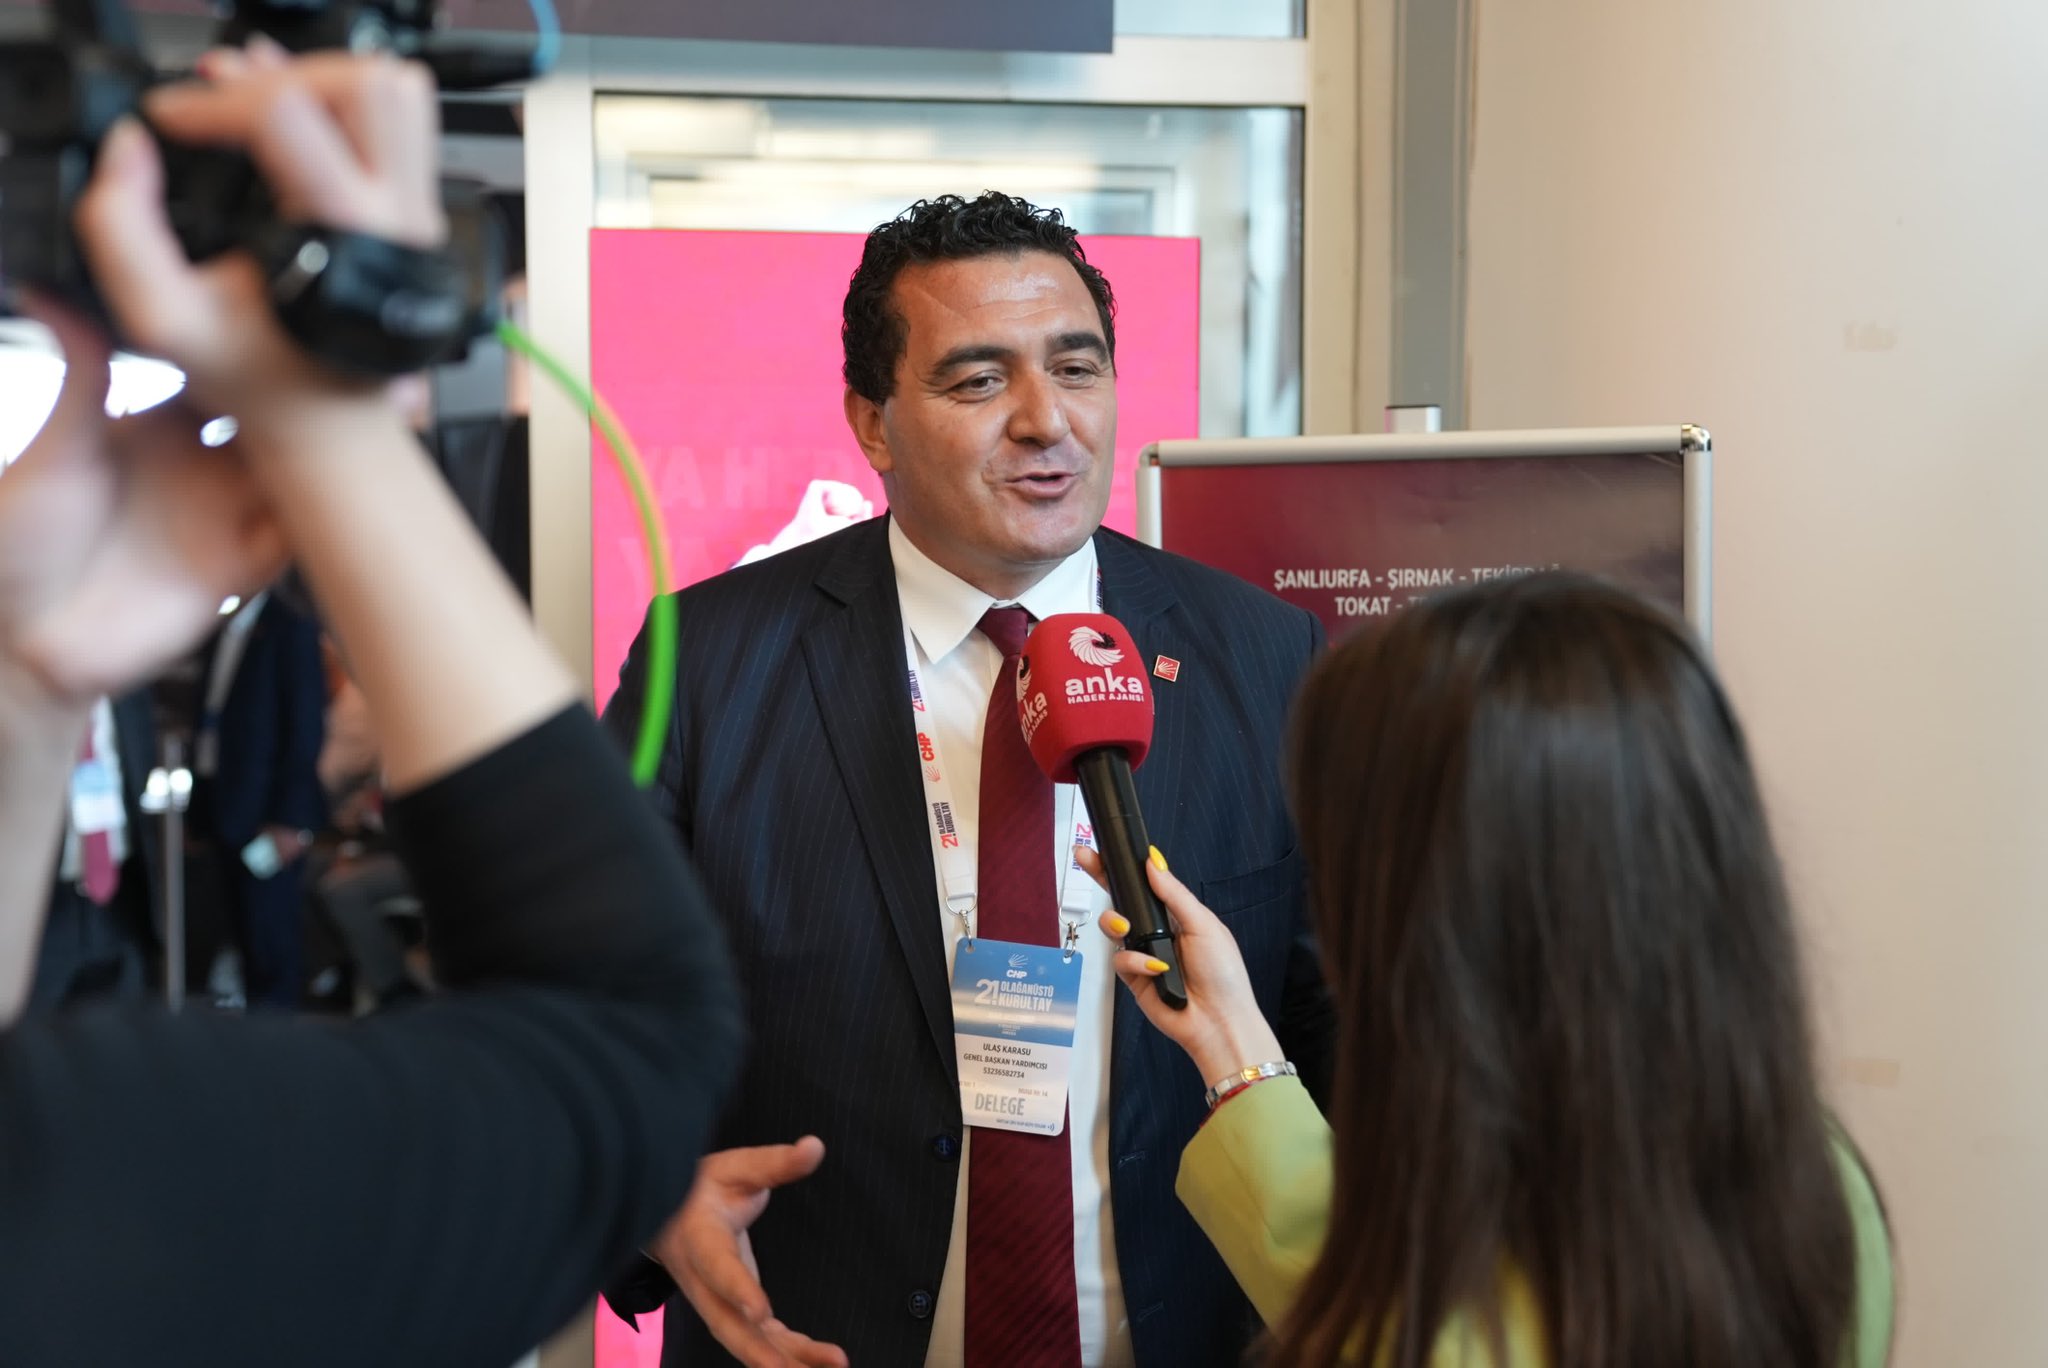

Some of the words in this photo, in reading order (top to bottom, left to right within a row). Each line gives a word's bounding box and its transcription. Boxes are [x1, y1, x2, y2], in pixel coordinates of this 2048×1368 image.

[1274, 569, 1371, 591] ŞANLIURFA
[1387, 568, 1455, 591] ŞIRNAK
[1334, 596, 1392, 617] TOKAT
[1065, 667, 1144, 696] anka
[1067, 694, 1106, 705] HABER
[917, 732, 935, 762] CHP
[940, 802, 955, 834] KURULTAY
[1006, 969, 1028, 979] CHP
[998, 992, 1053, 1012] KURULTAY
[982, 1043, 1001, 1053] ULAŞ
[1002, 1046, 1031, 1056] KARASU
[963, 1053, 983, 1062] GENEL
[984, 1055, 1010, 1065] BAŞKAN
[1011, 1059, 1048, 1070] YARDIMCISI
[974, 1093, 1026, 1116] DELEGE
